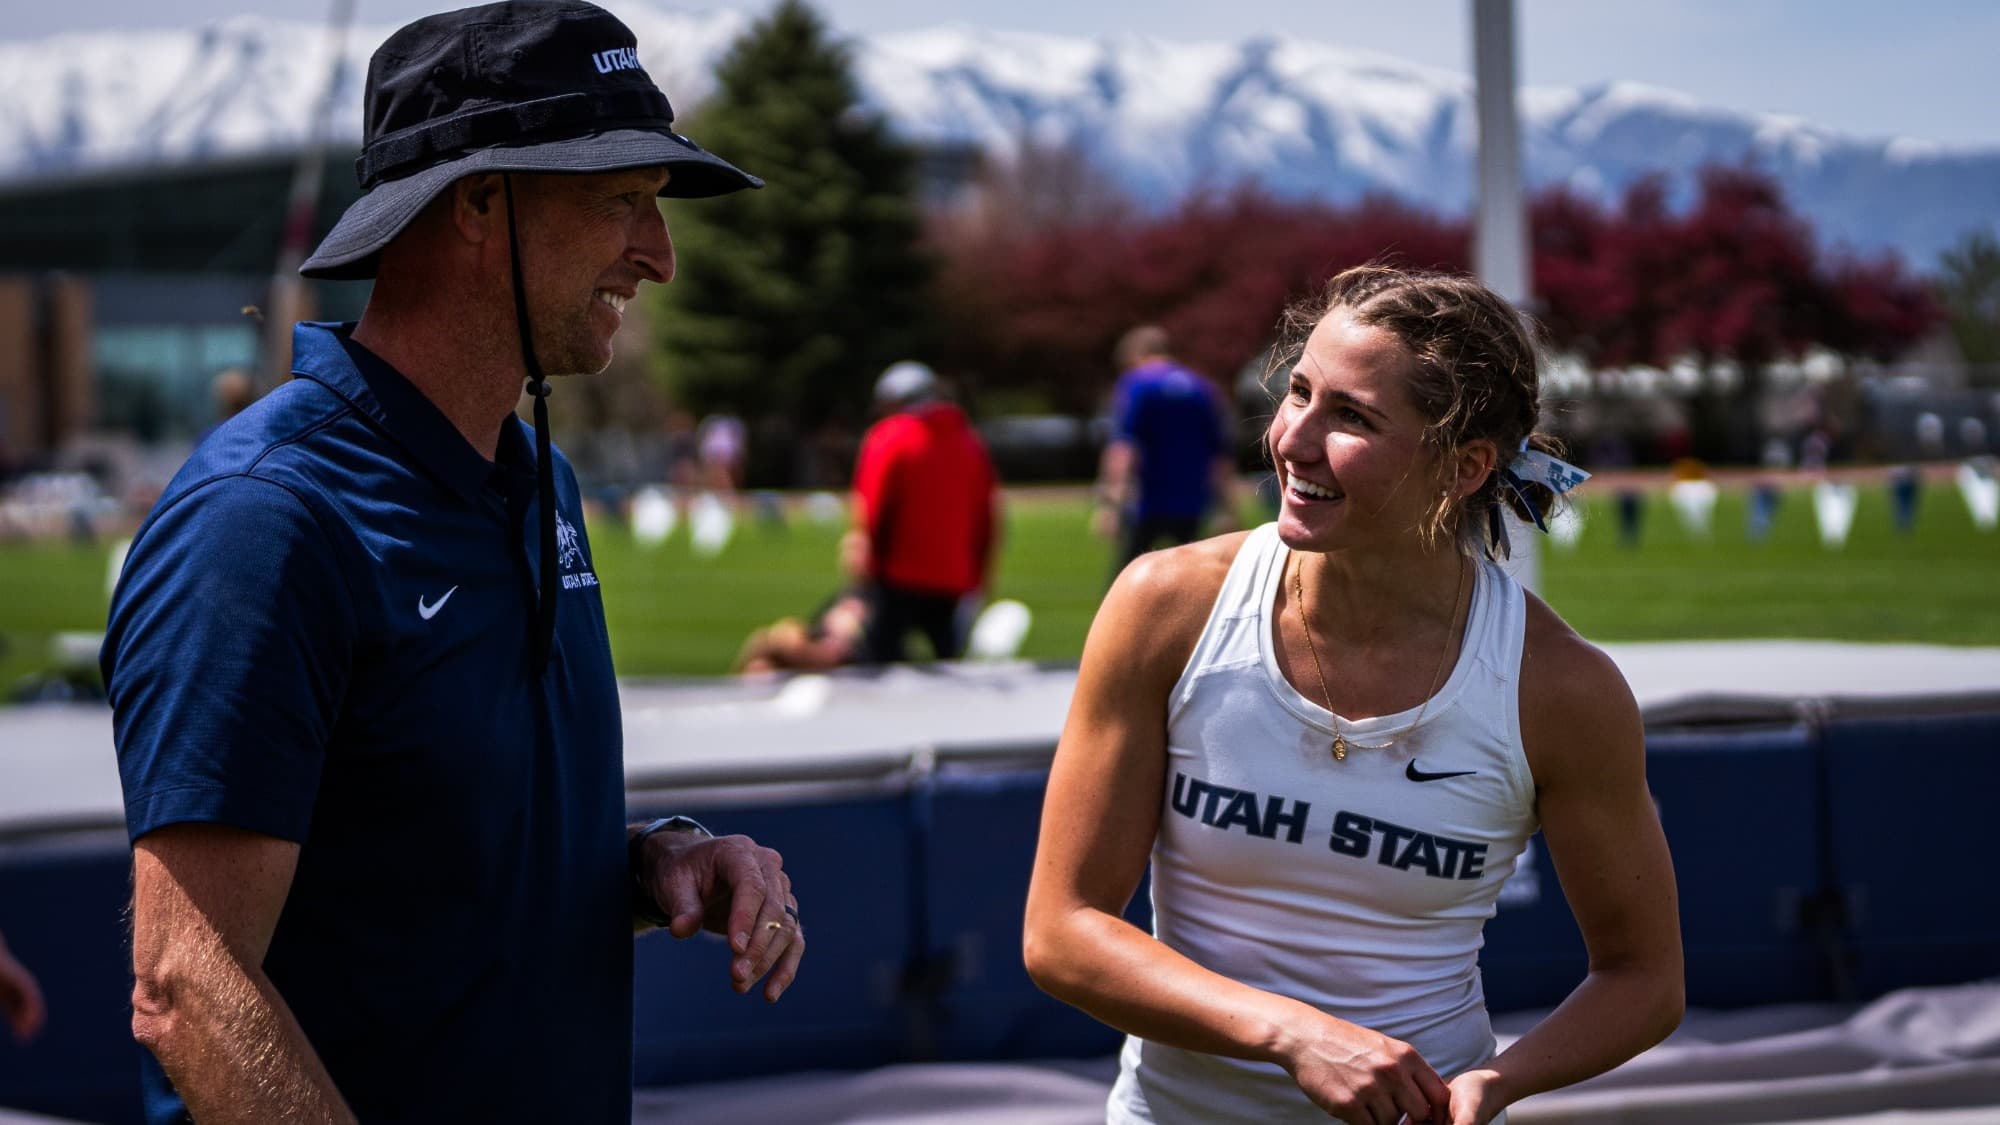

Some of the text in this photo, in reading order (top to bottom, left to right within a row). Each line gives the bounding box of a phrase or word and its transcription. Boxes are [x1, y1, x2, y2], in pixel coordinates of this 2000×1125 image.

[592, 47, 639, 73] UTAH
[562, 573, 581, 589] UTAH
[1171, 772, 1311, 844] UTAH
[1329, 810, 1488, 880] STATE
